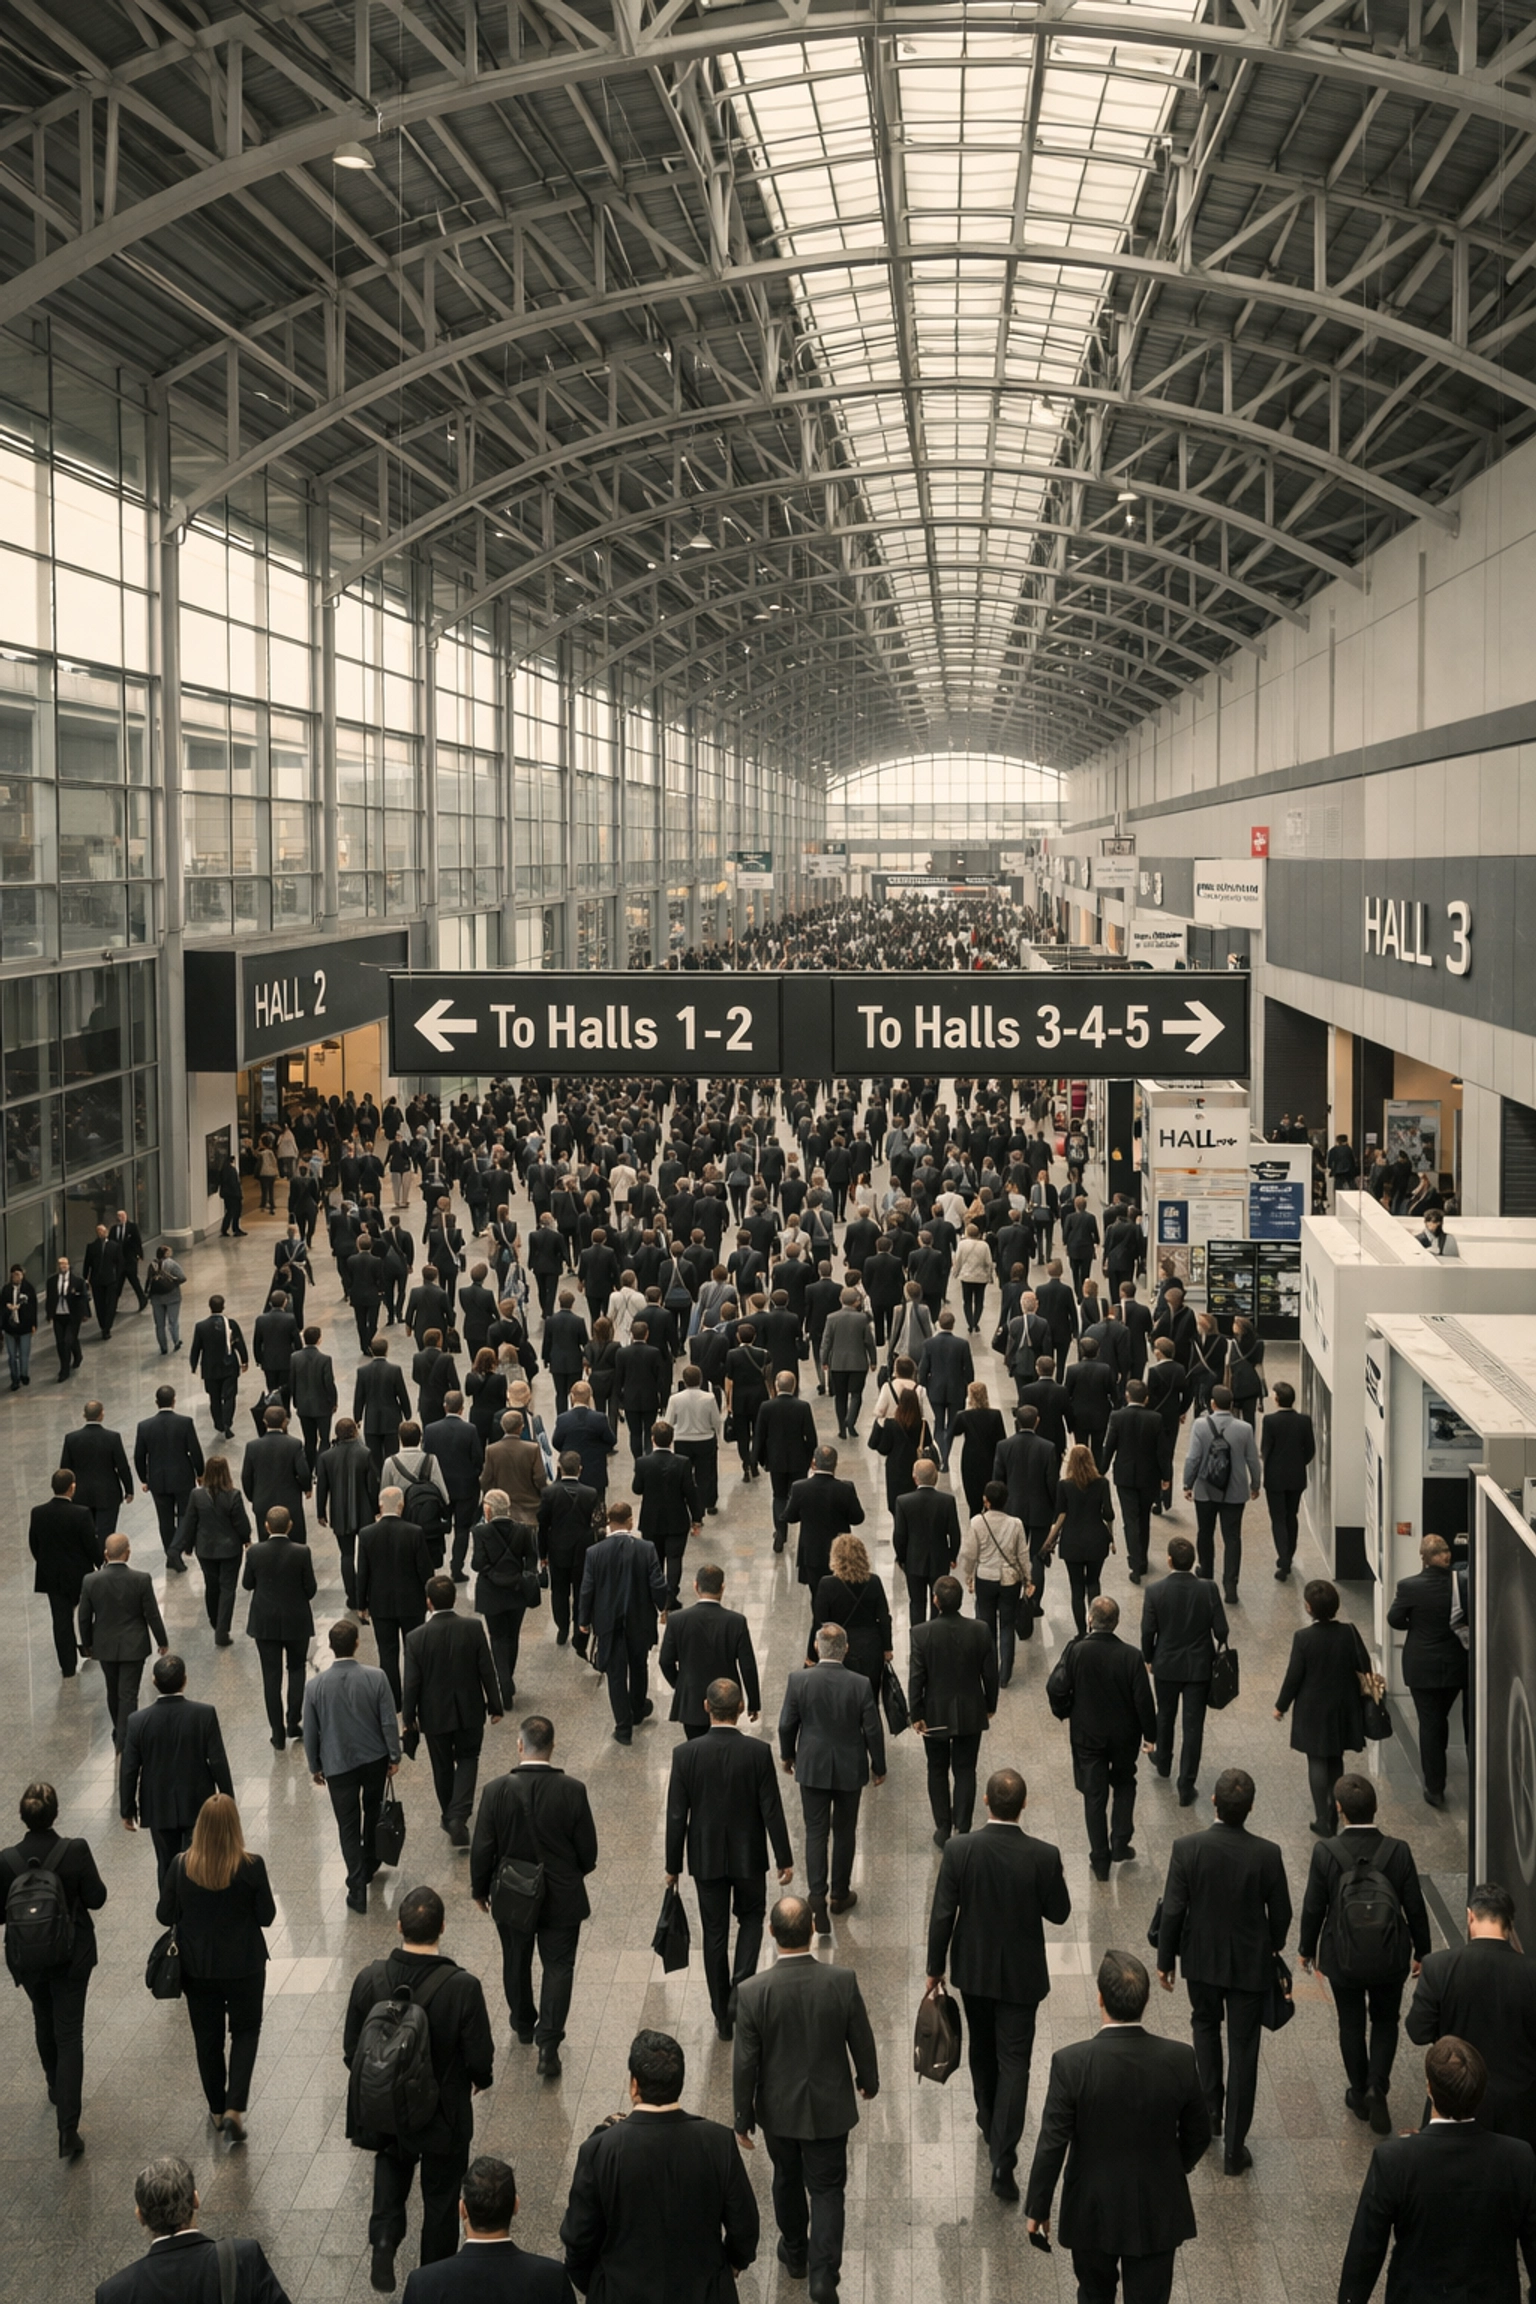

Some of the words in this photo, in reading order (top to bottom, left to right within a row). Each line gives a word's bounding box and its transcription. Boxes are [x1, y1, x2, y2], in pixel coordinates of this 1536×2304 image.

[1364, 896, 1433, 966] HALL
[1445, 900, 1471, 975] 3
[255, 976, 305, 1029] HALL
[314, 969, 327, 1016] 2
[489, 1004, 536, 1049] To
[548, 1004, 658, 1050] Halls
[676, 1005, 753, 1051] 1-2
[857, 1004, 902, 1049] To
[914, 1004, 1020, 1049] Halls
[1036, 1004, 1150, 1049] 3-4-5
